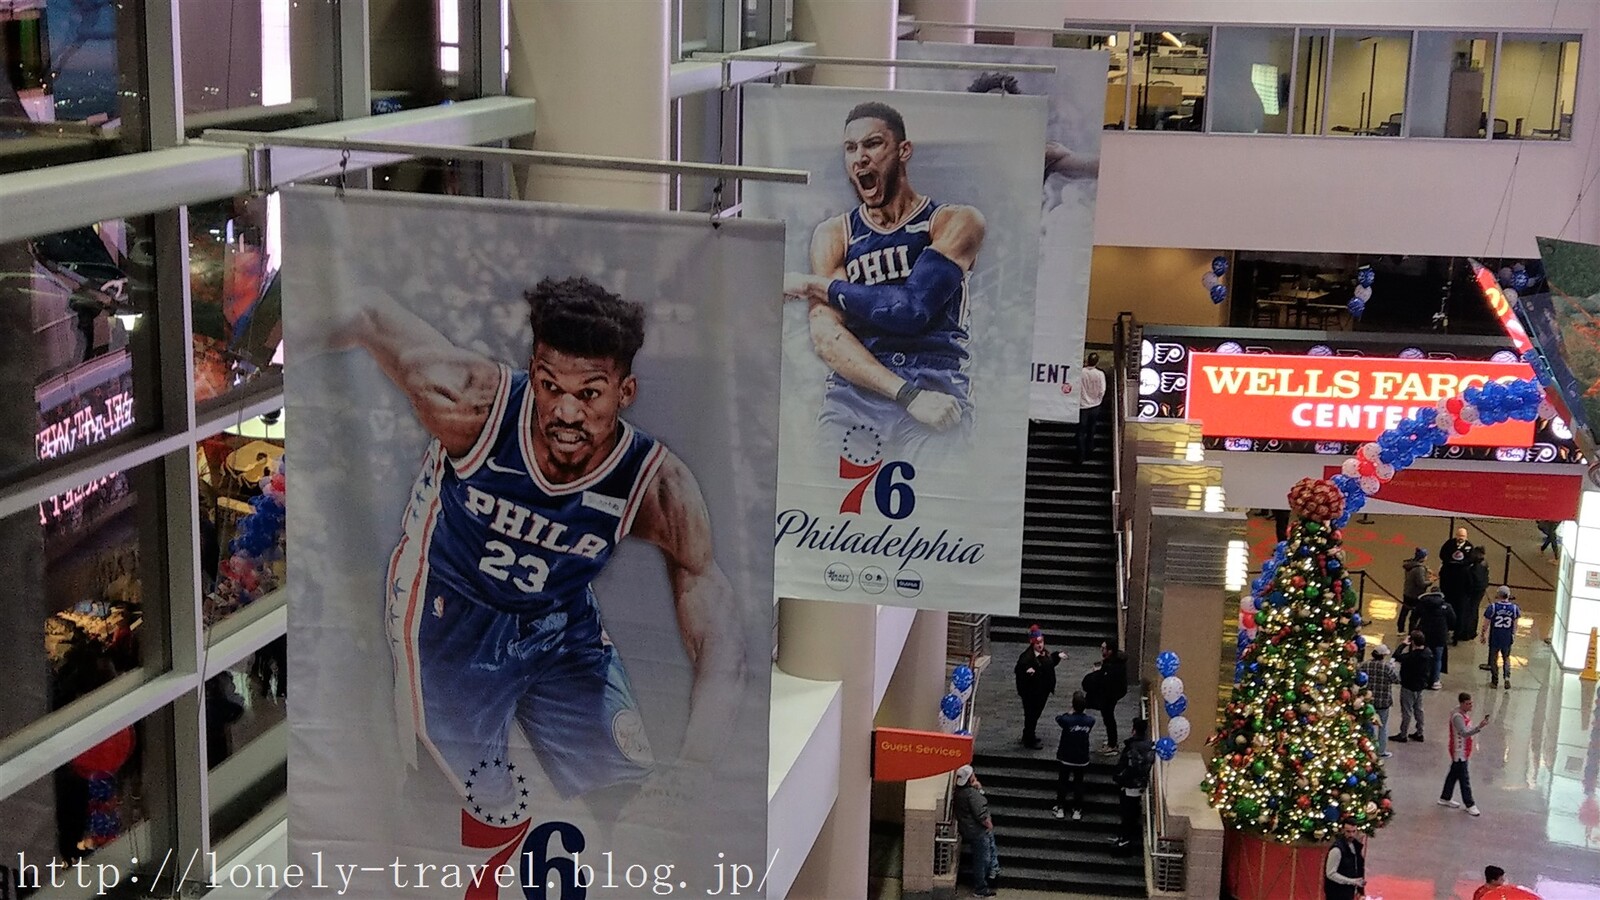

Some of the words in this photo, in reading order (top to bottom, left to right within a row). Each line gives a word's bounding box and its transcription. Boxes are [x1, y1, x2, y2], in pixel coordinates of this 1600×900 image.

[1202, 366, 1360, 398] WELLS
[1370, 371, 1519, 402] FARG
[839, 456, 916, 520] 76
[466, 487, 609, 559] PHILA
[773, 509, 985, 570] Philadelphia
[479, 540, 550, 593] 23
[1494, 616, 1512, 628] 23
[881, 741, 912, 752] Guest
[915, 744, 962, 757] Services
